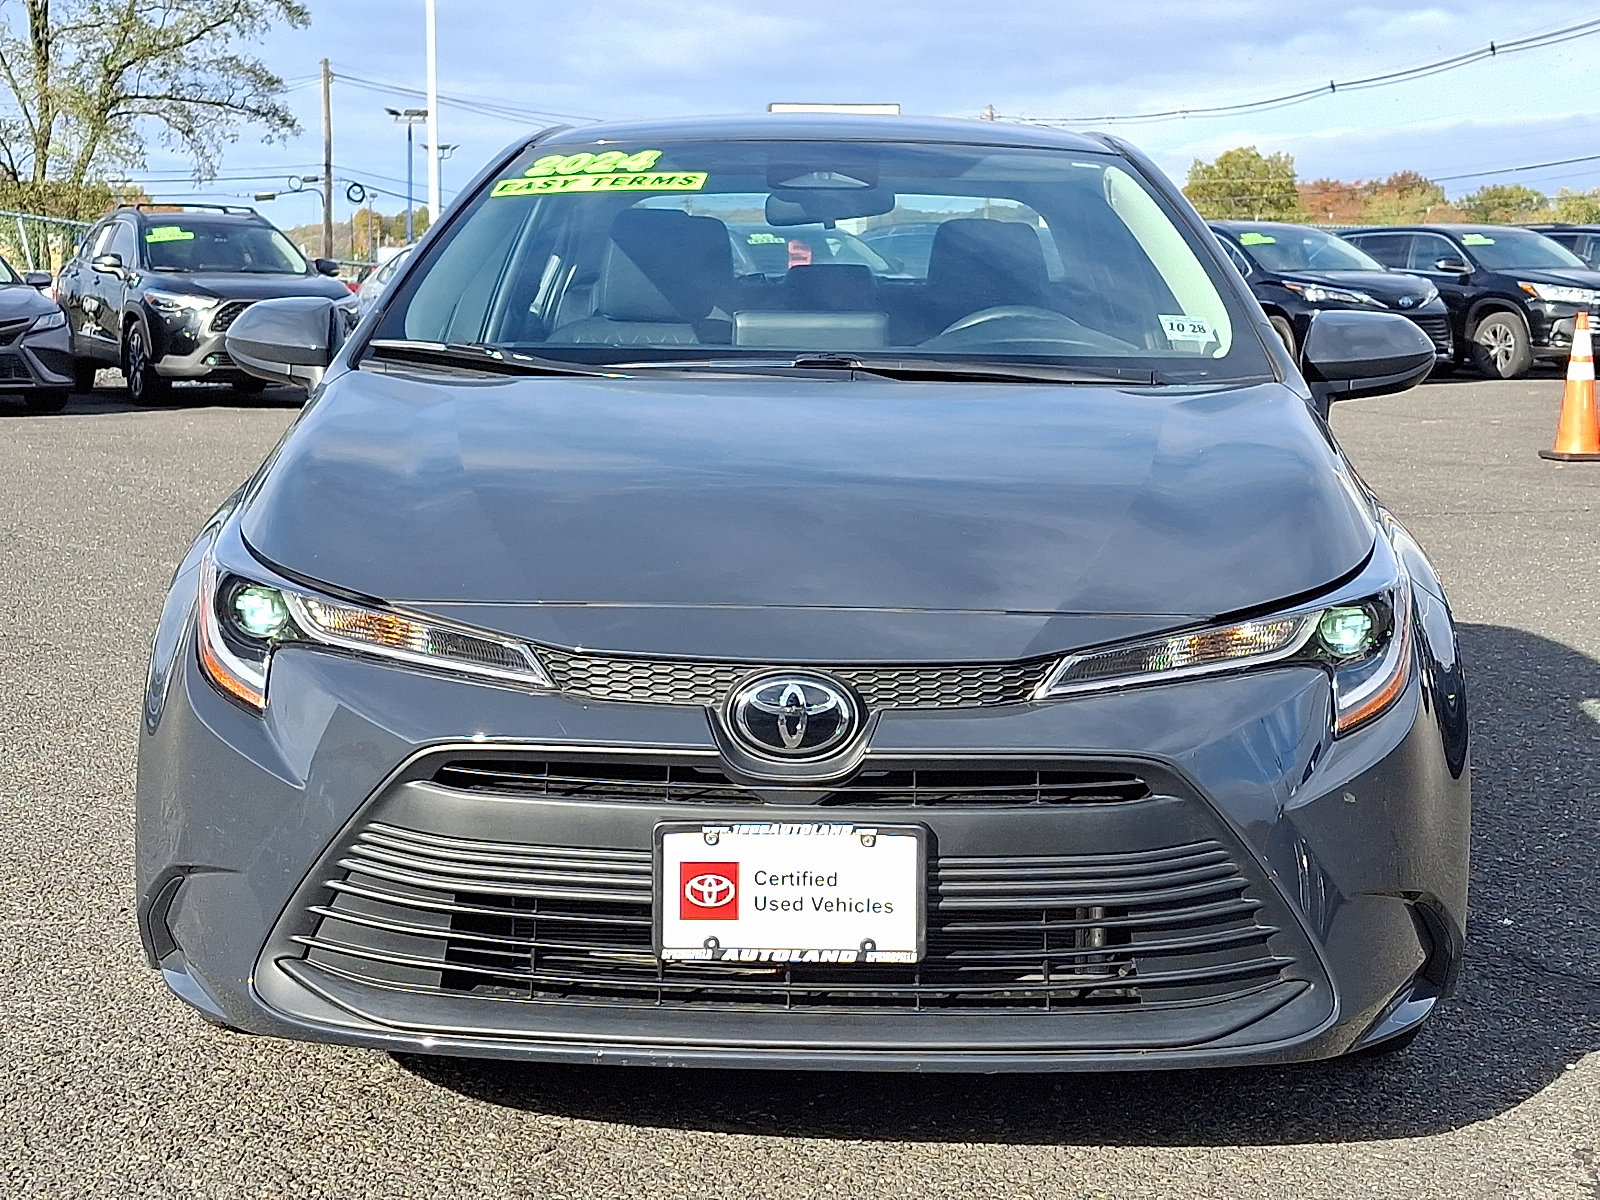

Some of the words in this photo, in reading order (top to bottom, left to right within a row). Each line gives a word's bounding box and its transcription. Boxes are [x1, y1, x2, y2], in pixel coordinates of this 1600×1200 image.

[524, 150, 663, 178] 2024
[498, 179, 580, 193] EASY
[591, 175, 701, 188] TERMS
[1168, 322, 1186, 333] 10
[1189, 323, 1207, 334] 28
[754, 870, 838, 888] Certified
[754, 895, 804, 912] Used
[811, 896, 894, 914] Vehicles
[720, 949, 859, 963] AUTOLAND
